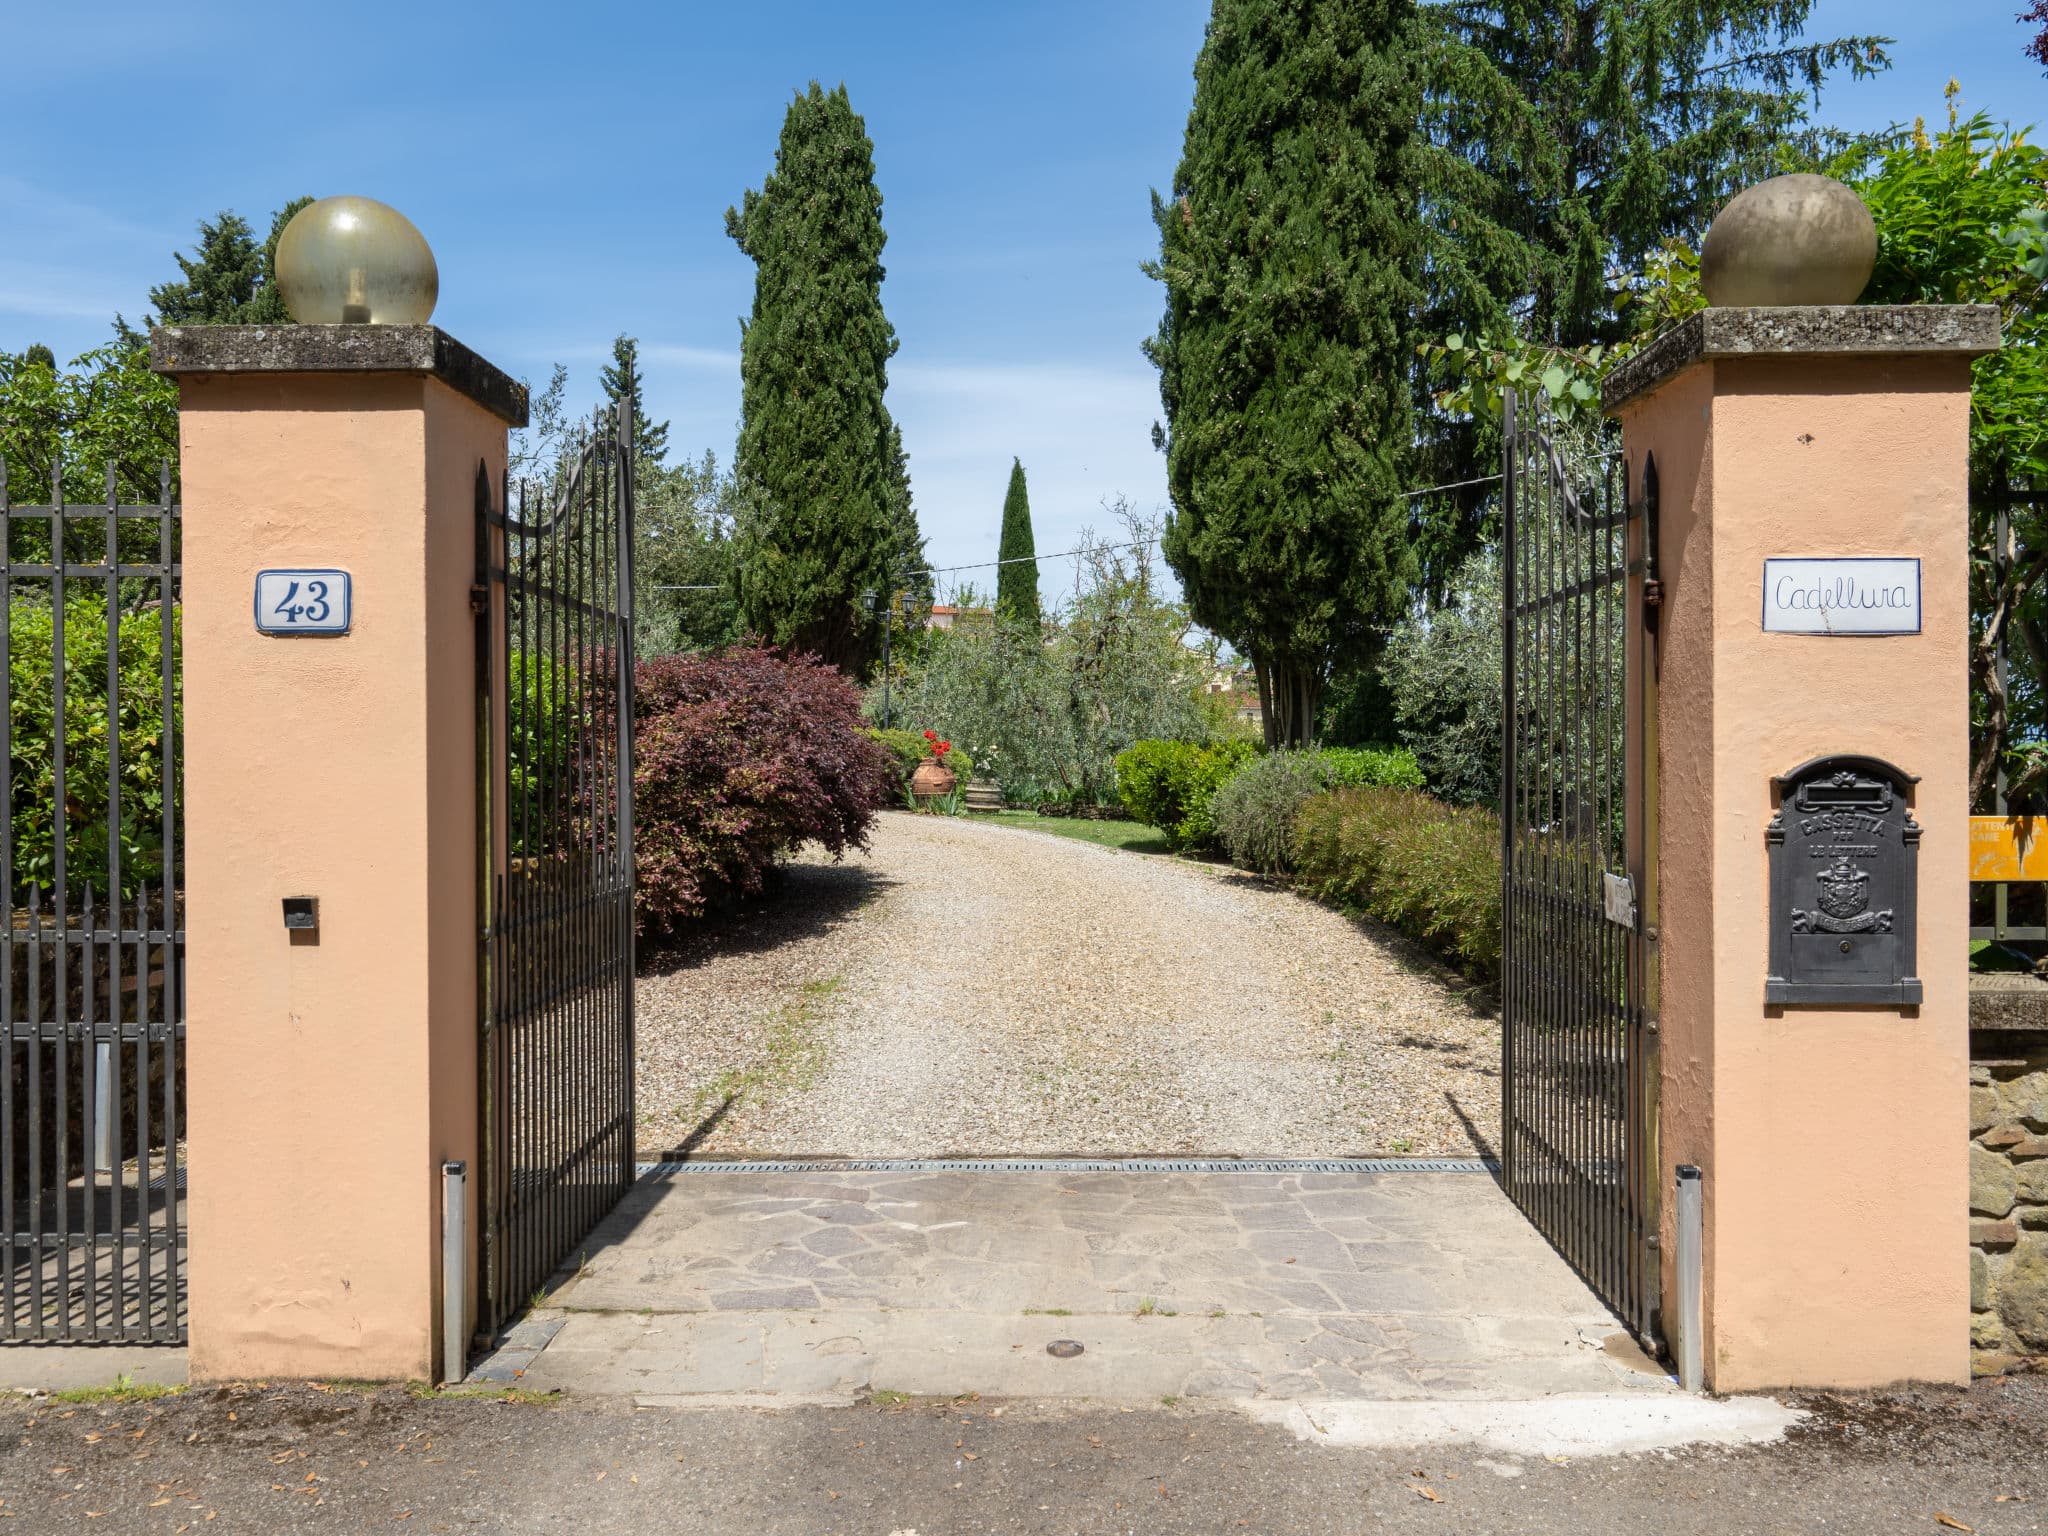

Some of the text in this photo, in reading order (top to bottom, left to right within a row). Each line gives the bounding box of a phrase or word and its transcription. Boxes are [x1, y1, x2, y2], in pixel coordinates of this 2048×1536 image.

[274, 580, 330, 623] 43
[1776, 575, 1912, 610] Cadellura
[1800, 812, 1886, 837] CASSETTA
[1832, 831, 1855, 841] PER
[1810, 845, 1879, 858] LE LETTERE
